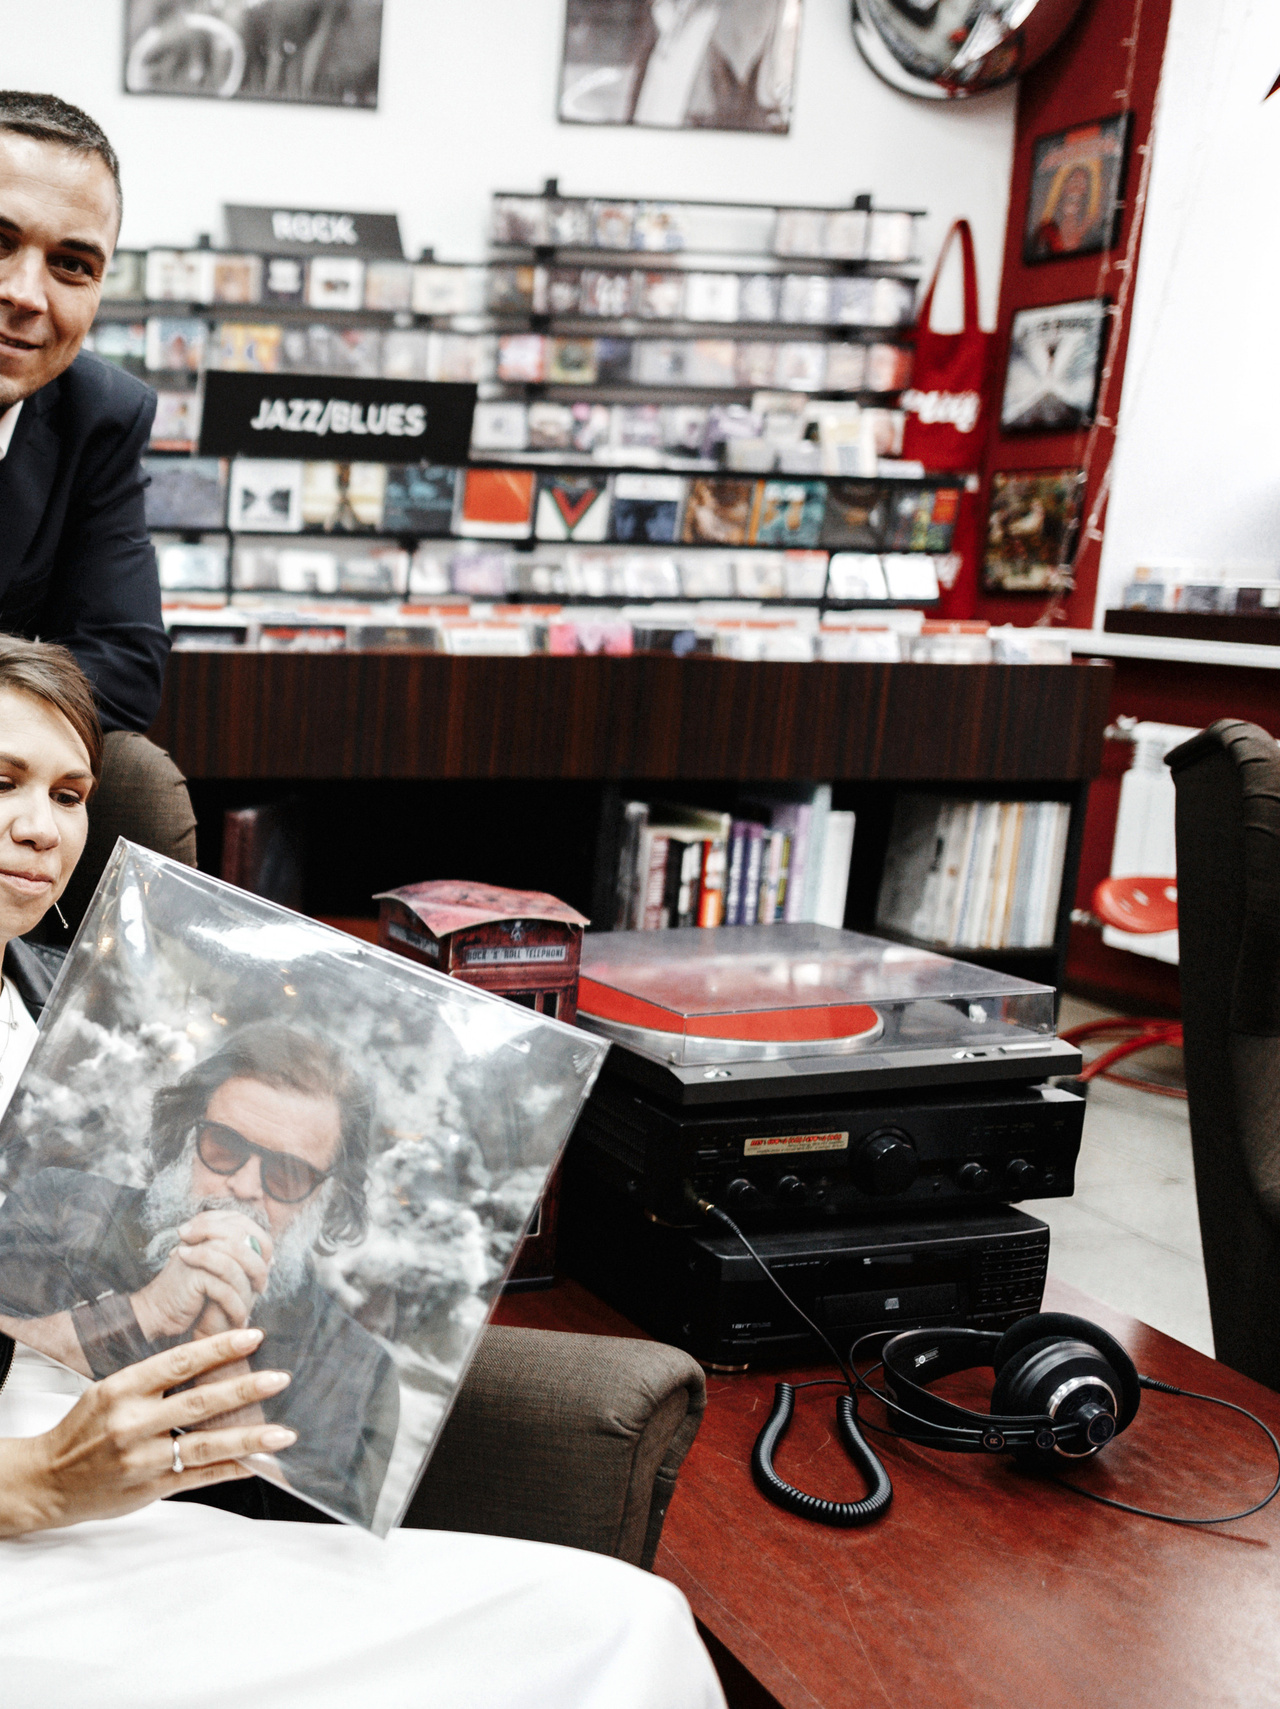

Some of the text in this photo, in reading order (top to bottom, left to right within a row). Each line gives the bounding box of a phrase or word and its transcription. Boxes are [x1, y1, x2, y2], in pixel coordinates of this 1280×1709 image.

[272, 210, 359, 245] ROCK
[250, 398, 427, 436] JAZZ/BLUES
[466, 950, 486, 960] ROCK
[504, 947, 522, 958] ROLL
[525, 946, 565, 958] TELEPHONE
